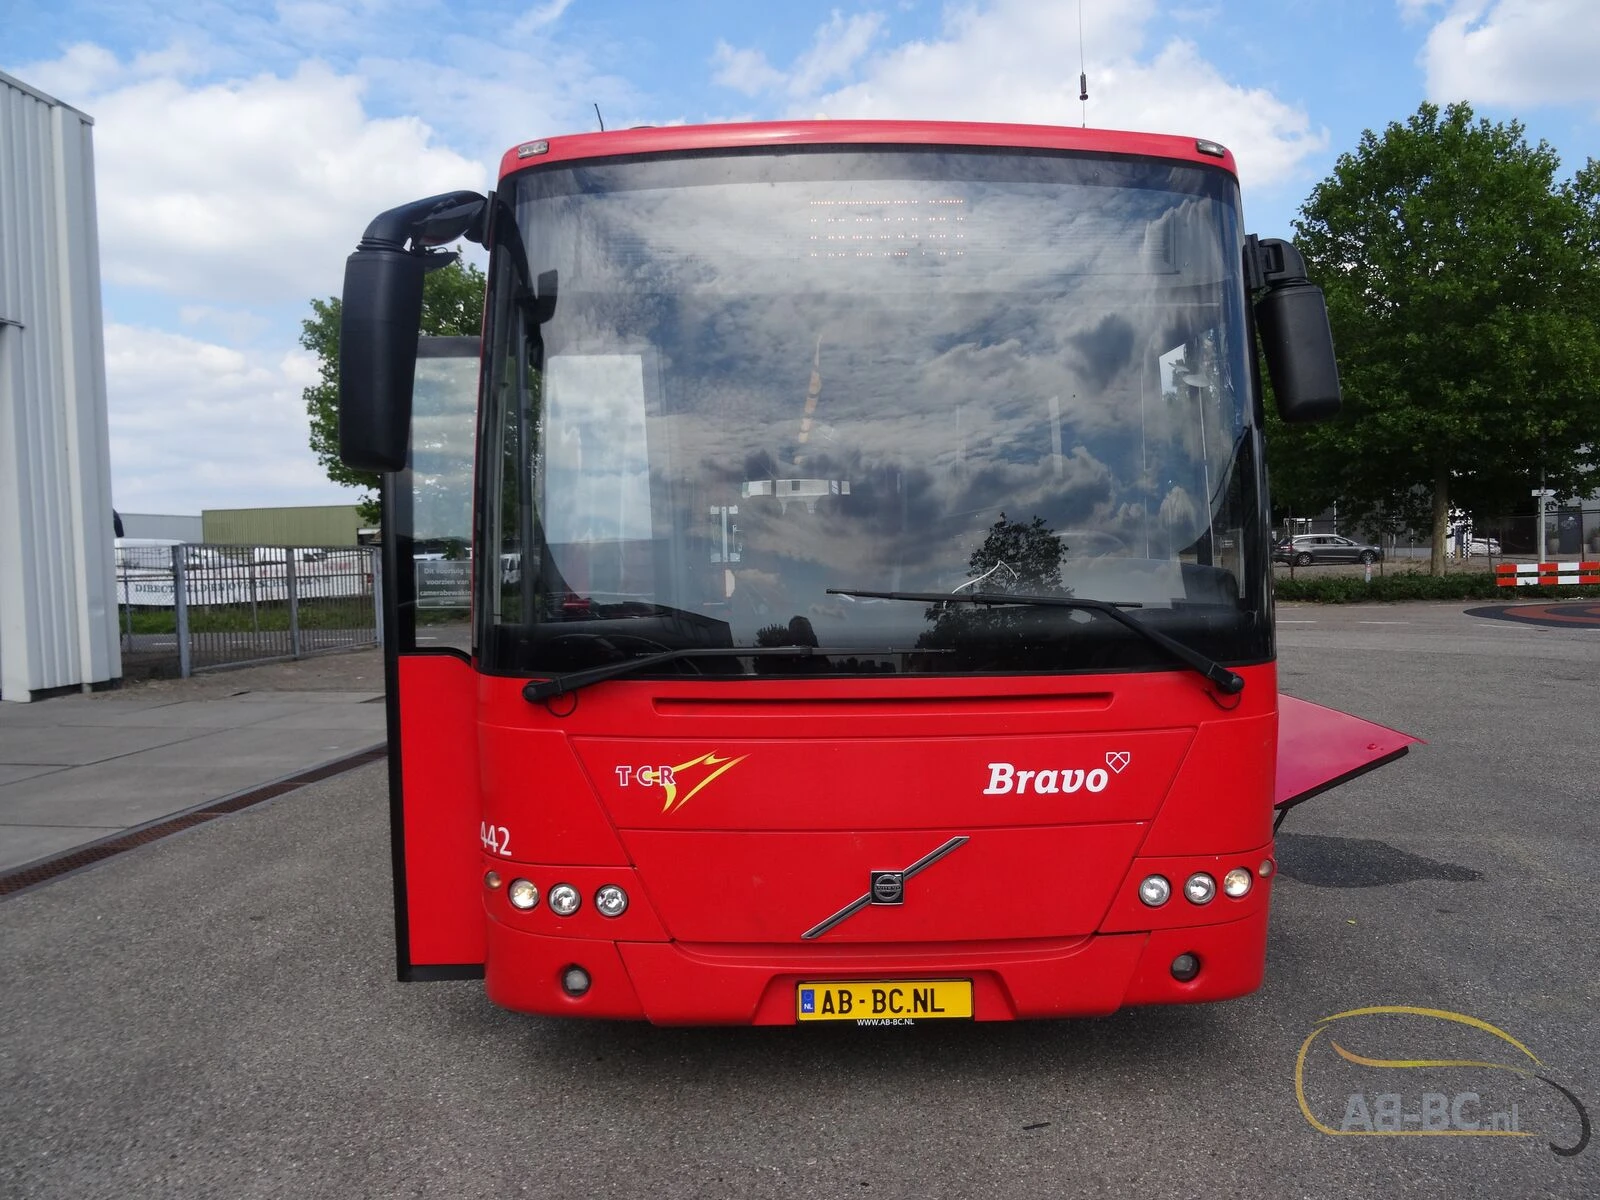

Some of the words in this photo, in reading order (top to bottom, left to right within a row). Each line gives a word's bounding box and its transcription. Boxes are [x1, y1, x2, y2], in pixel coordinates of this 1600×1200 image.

[135, 584, 175, 593] DIRECT
[615, 765, 677, 787] TCR
[982, 762, 1109, 795] Bravo
[480, 820, 513, 856] 442
[803, 1003, 814, 1011] NL
[857, 1018, 915, 1026] WWW.AB-BC.NL
